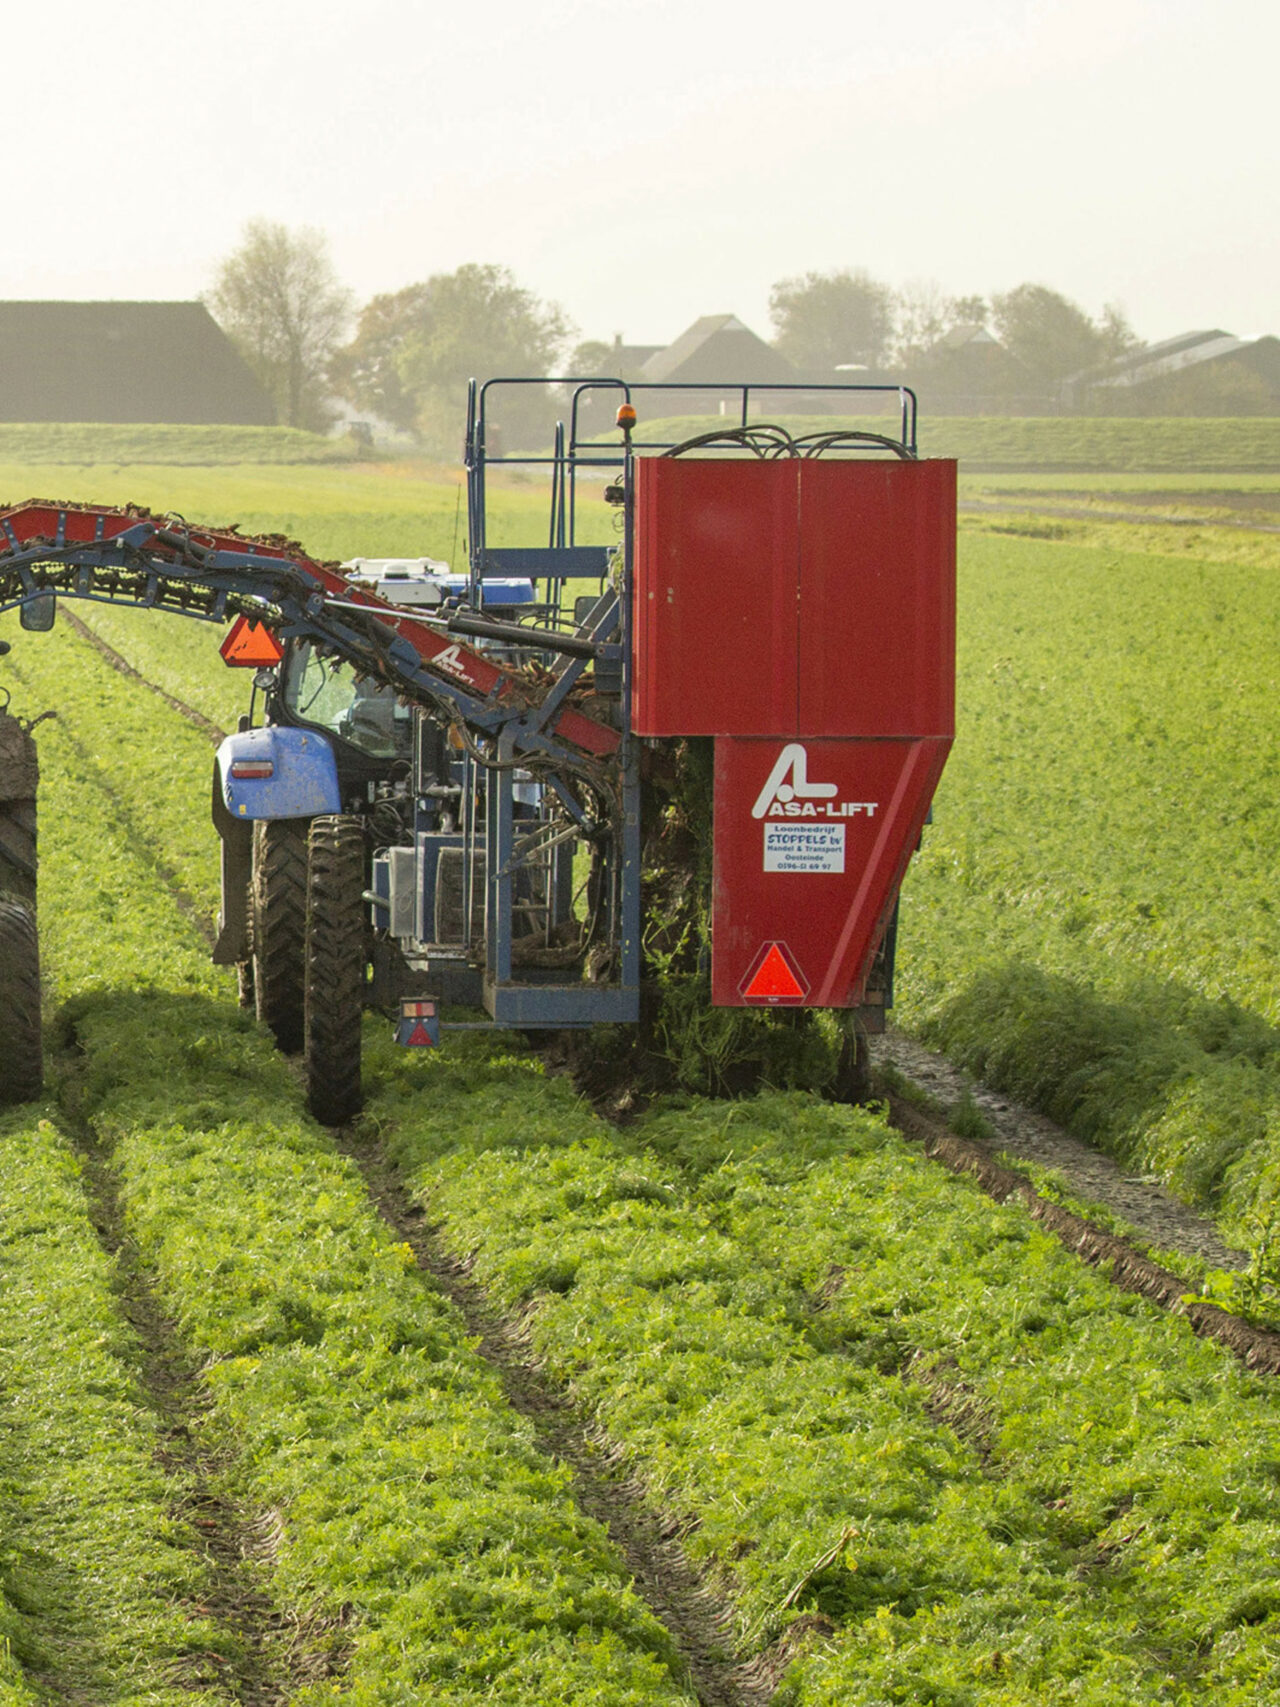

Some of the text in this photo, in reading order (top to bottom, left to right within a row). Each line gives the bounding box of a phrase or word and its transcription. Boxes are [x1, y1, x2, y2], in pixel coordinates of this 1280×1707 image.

[768, 802, 879, 817] ASA-LIFT
[774, 825, 836, 835] Loonbedrijf
[767, 834, 843, 845] STOPPELS bv
